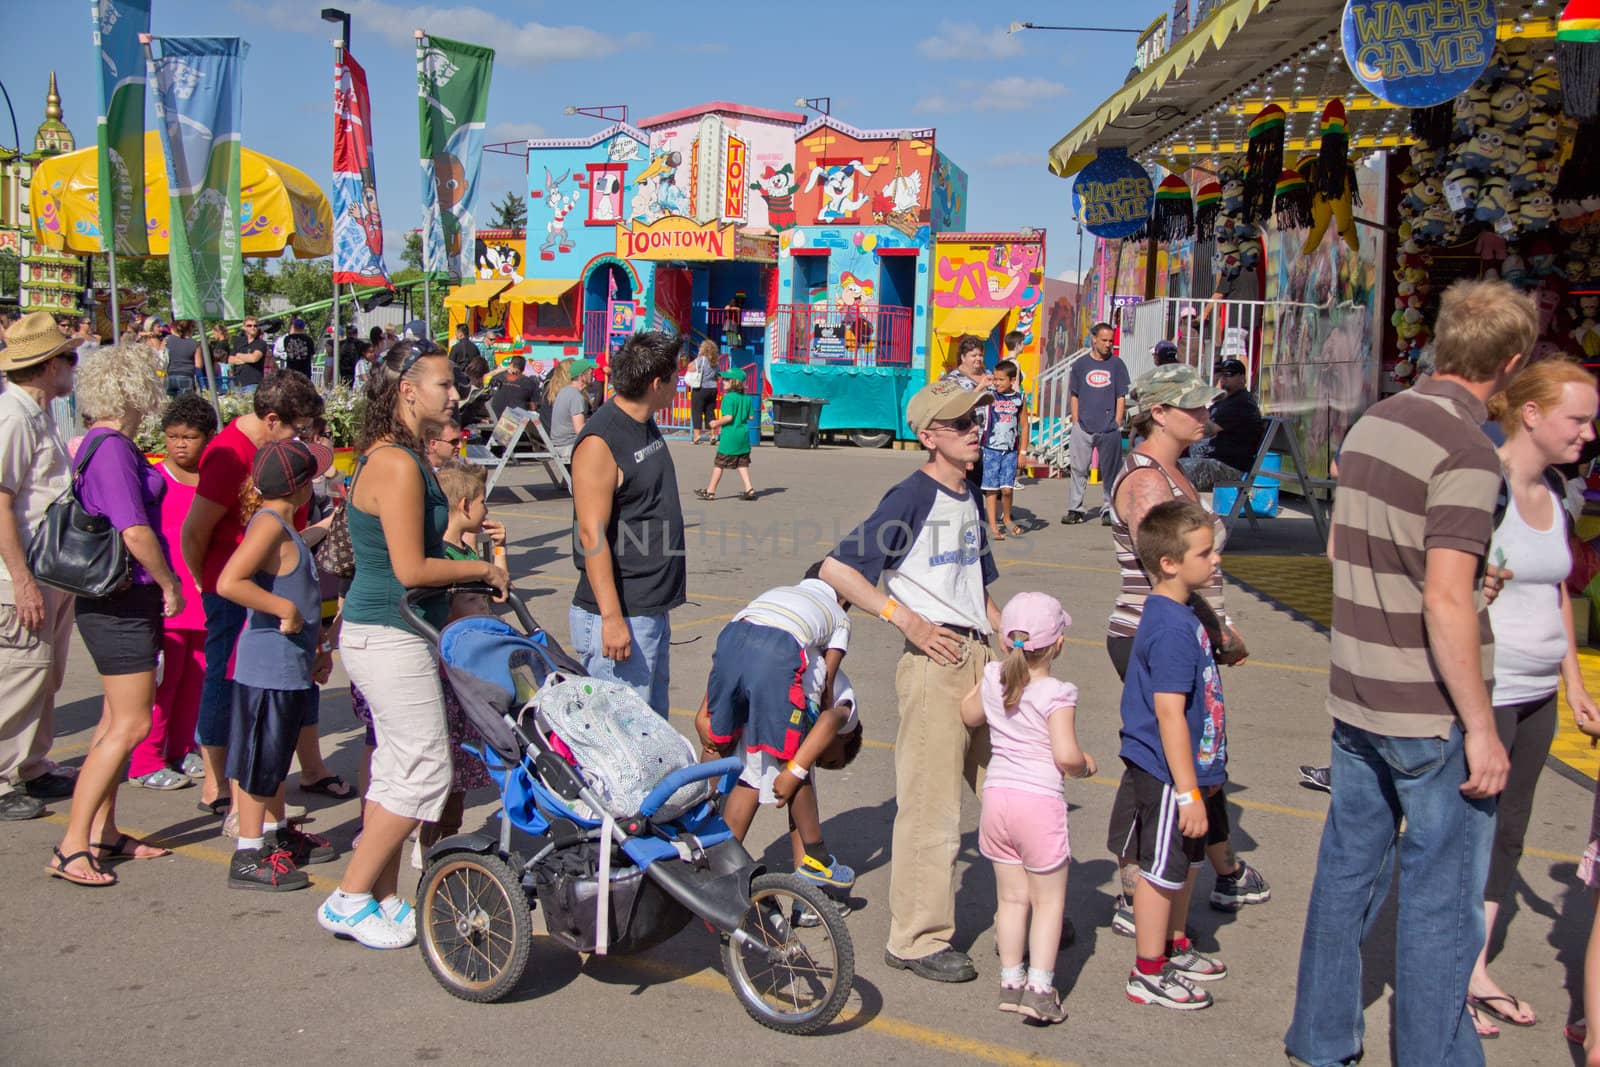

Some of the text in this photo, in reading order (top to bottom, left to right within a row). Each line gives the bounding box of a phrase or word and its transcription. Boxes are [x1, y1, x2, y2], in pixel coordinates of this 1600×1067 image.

[1351, 0, 1493, 43] WATER
[1356, 31, 1485, 82] GAME
[727, 144, 743, 216] TOWN
[1075, 177, 1152, 203] WATER
[1080, 197, 1148, 225] GAME
[621, 230, 727, 258] TOONTOWN
